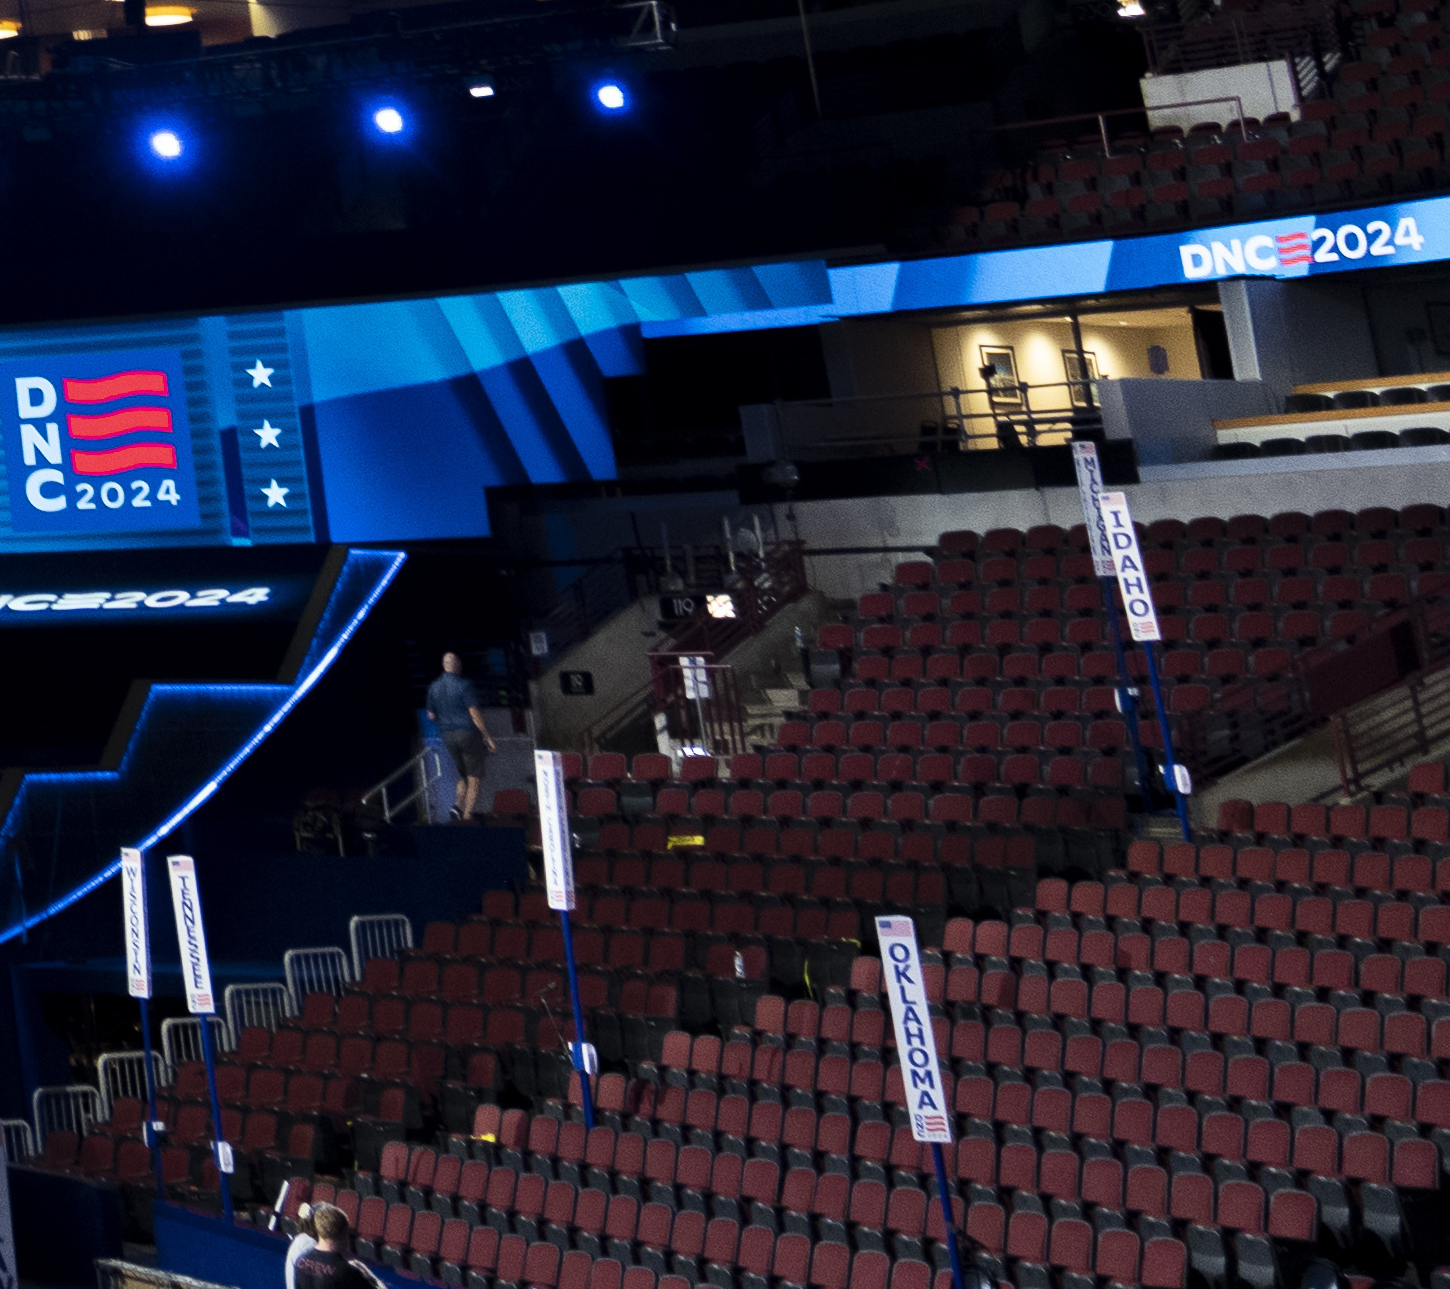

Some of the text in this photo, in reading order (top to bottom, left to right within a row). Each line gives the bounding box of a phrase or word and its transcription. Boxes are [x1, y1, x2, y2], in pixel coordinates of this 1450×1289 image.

[1179, 216, 1426, 280] DNC 2024
[14, 375, 69, 513] DNC
[74, 478, 182, 511] 2024
[102, 587, 271, 610] 2024
[1110, 510, 1150, 617] IDAHO
[125, 865, 142, 976] WISCONSIN
[178, 875, 204, 990] TENNESSEE
[889, 942, 939, 1111] OKLAHOMA
